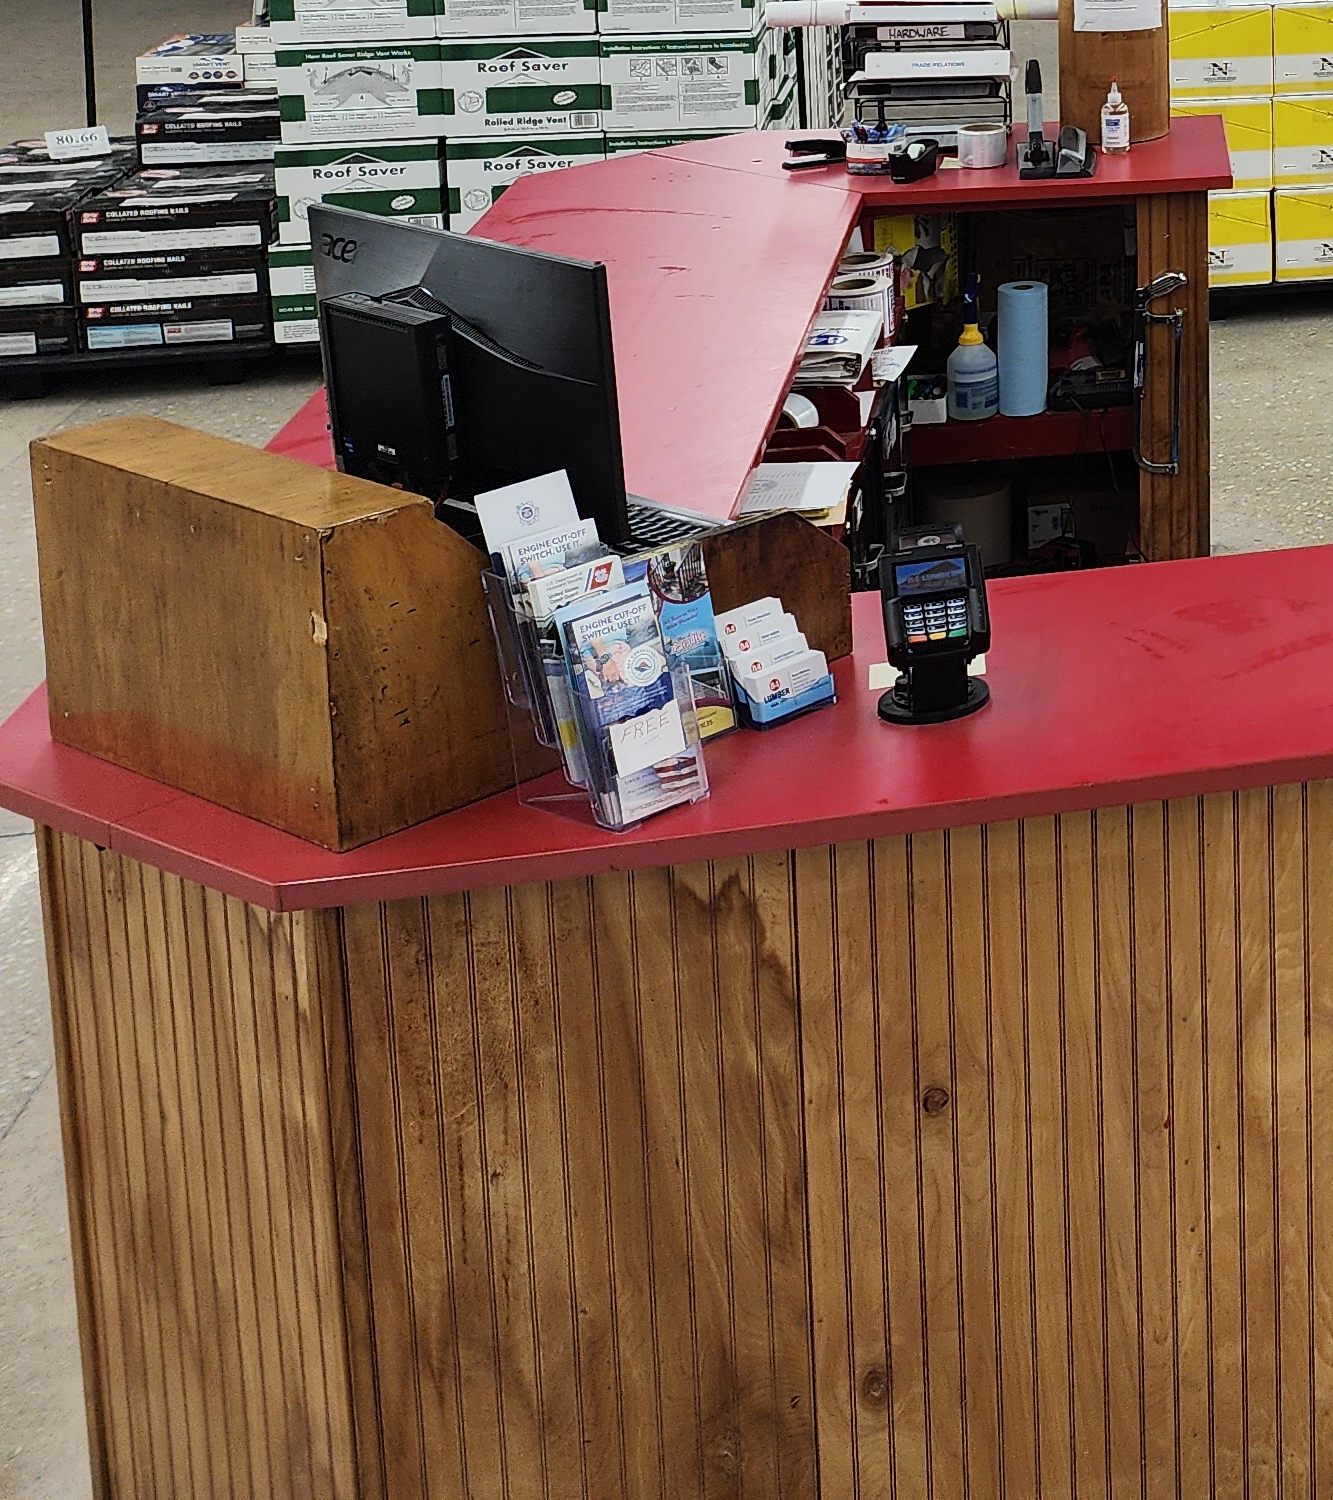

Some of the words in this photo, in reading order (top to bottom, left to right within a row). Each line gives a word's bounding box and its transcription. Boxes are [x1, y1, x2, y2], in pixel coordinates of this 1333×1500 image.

[887, 26, 950, 39] HARDWARE
[478, 62, 516, 74] Roof
[521, 60, 568, 72] Saver
[484, 117, 514, 127] Rolled
[516, 117, 544, 127] Ridge
[546, 116, 567, 126] Vent
[55, 133, 98, 145] 80.66
[483, 158, 521, 172] Roof
[524, 157, 574, 171] Saver
[312, 166, 352, 179] Roof
[358, 165, 407, 177] Saver
[518, 539, 551, 556] ENGINE
[552, 528, 587, 545] CUT-OFF
[555, 544, 570, 554] USE
[570, 540, 583, 549] IT.
[580, 616, 613, 633] ENGINE
[613, 603, 647, 621] CUT-OFF
[617, 619, 633, 630] USE
[620, 712, 670, 744] FREE
